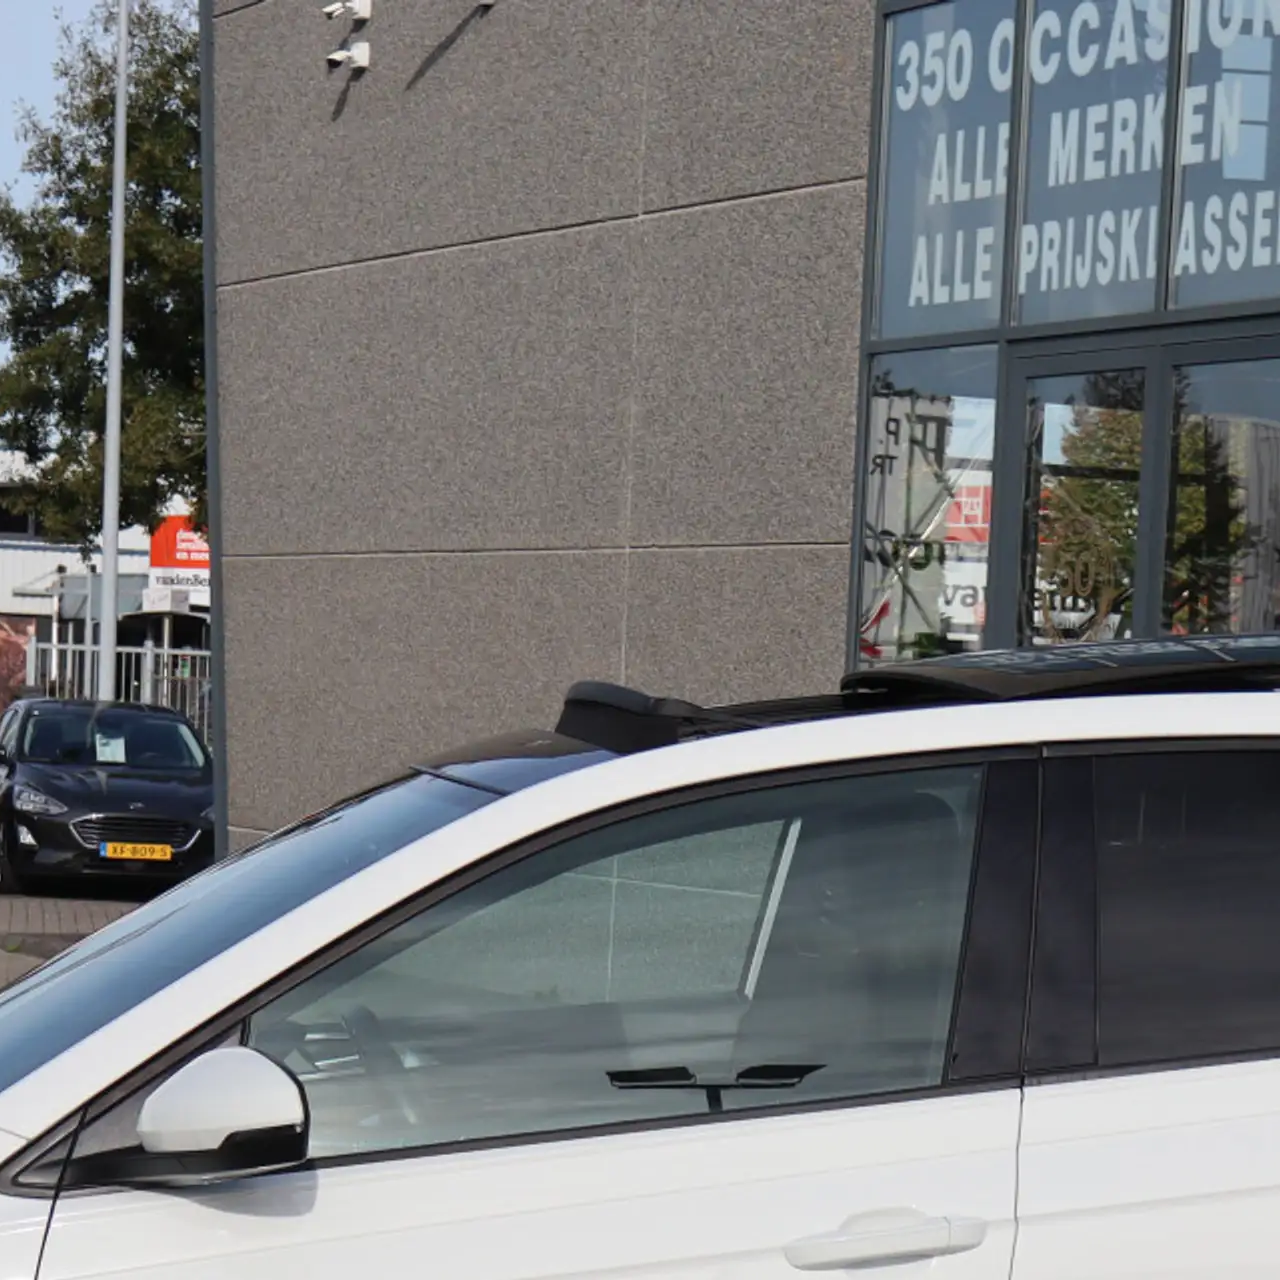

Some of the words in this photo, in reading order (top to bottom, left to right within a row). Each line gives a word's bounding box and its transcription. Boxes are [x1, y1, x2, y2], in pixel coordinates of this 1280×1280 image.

[896, 29, 974, 111] 350
[928, 123, 1010, 206] ALLE
[1047, 80, 1244, 188] MERKEN
[907, 227, 995, 307] ALLE
